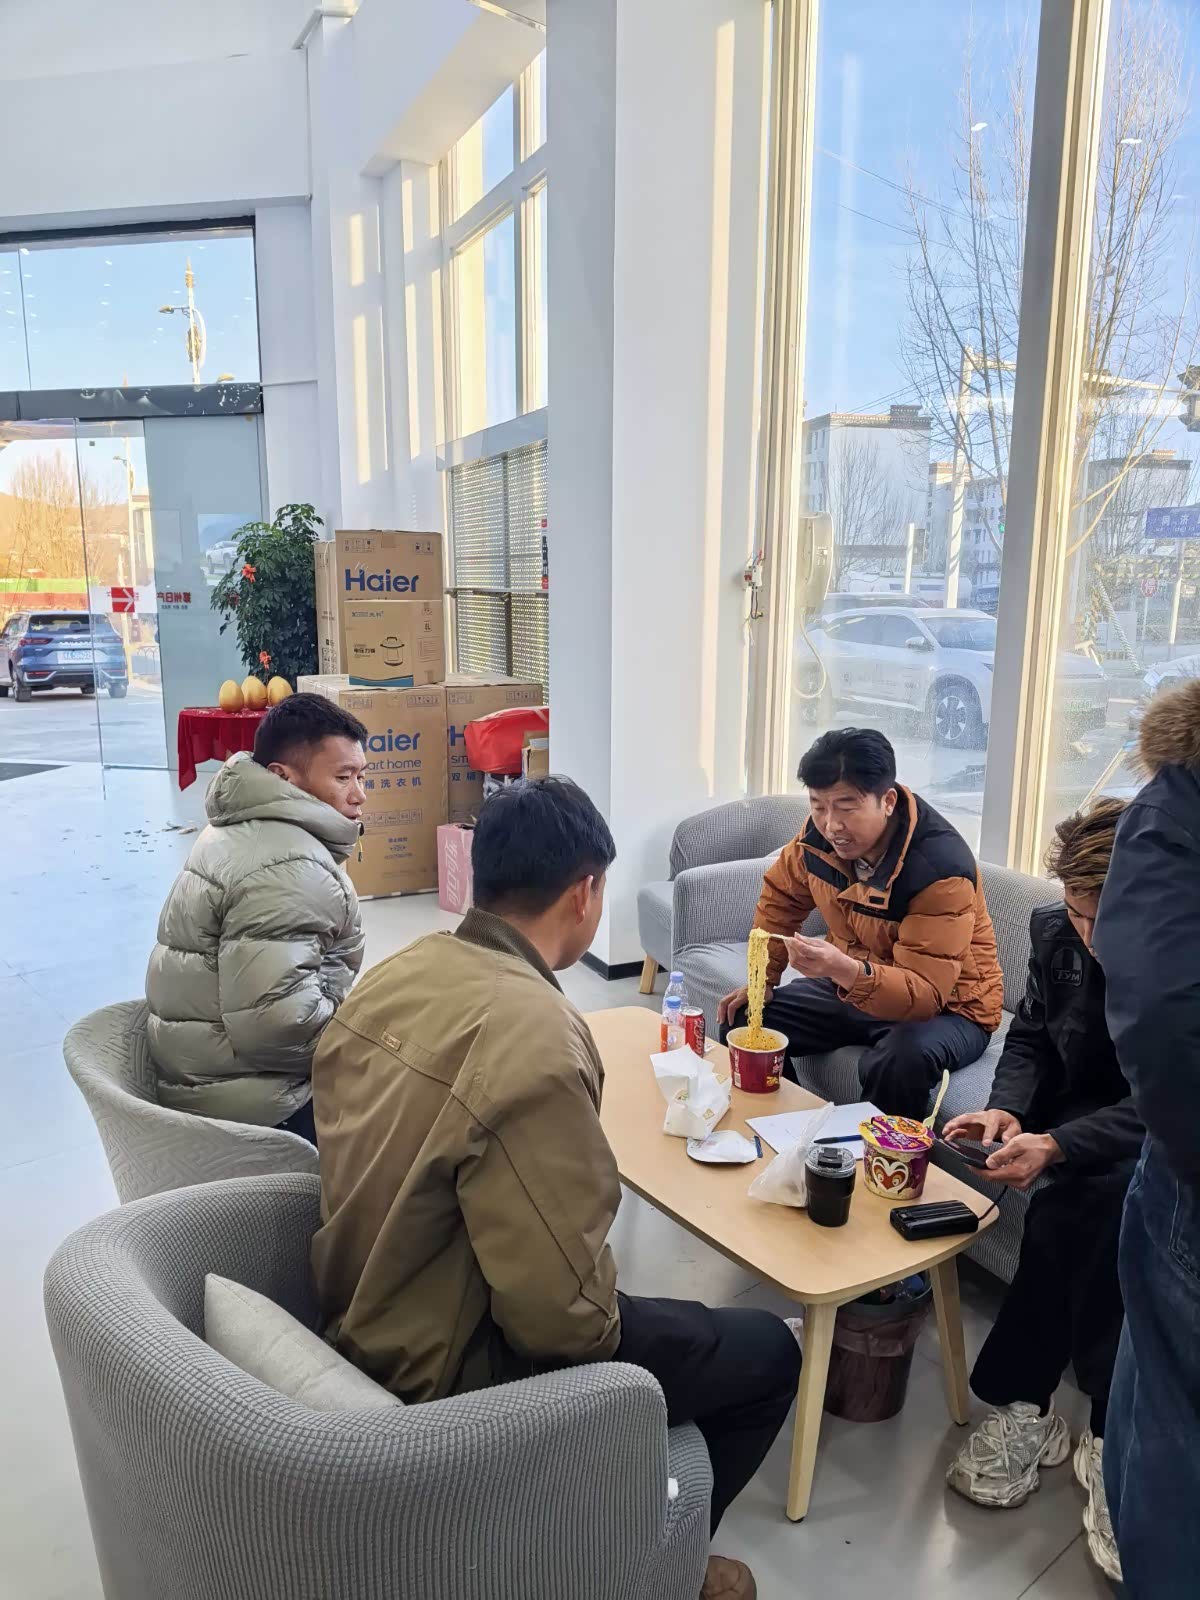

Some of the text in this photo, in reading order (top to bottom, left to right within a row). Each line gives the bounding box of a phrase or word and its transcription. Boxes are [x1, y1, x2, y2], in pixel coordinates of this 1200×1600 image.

[345, 568, 419, 593] Haier
[363, 728, 421, 753] aier
[367, 757, 422, 770] art home
[365, 776, 422, 790] 桶洗衣机
